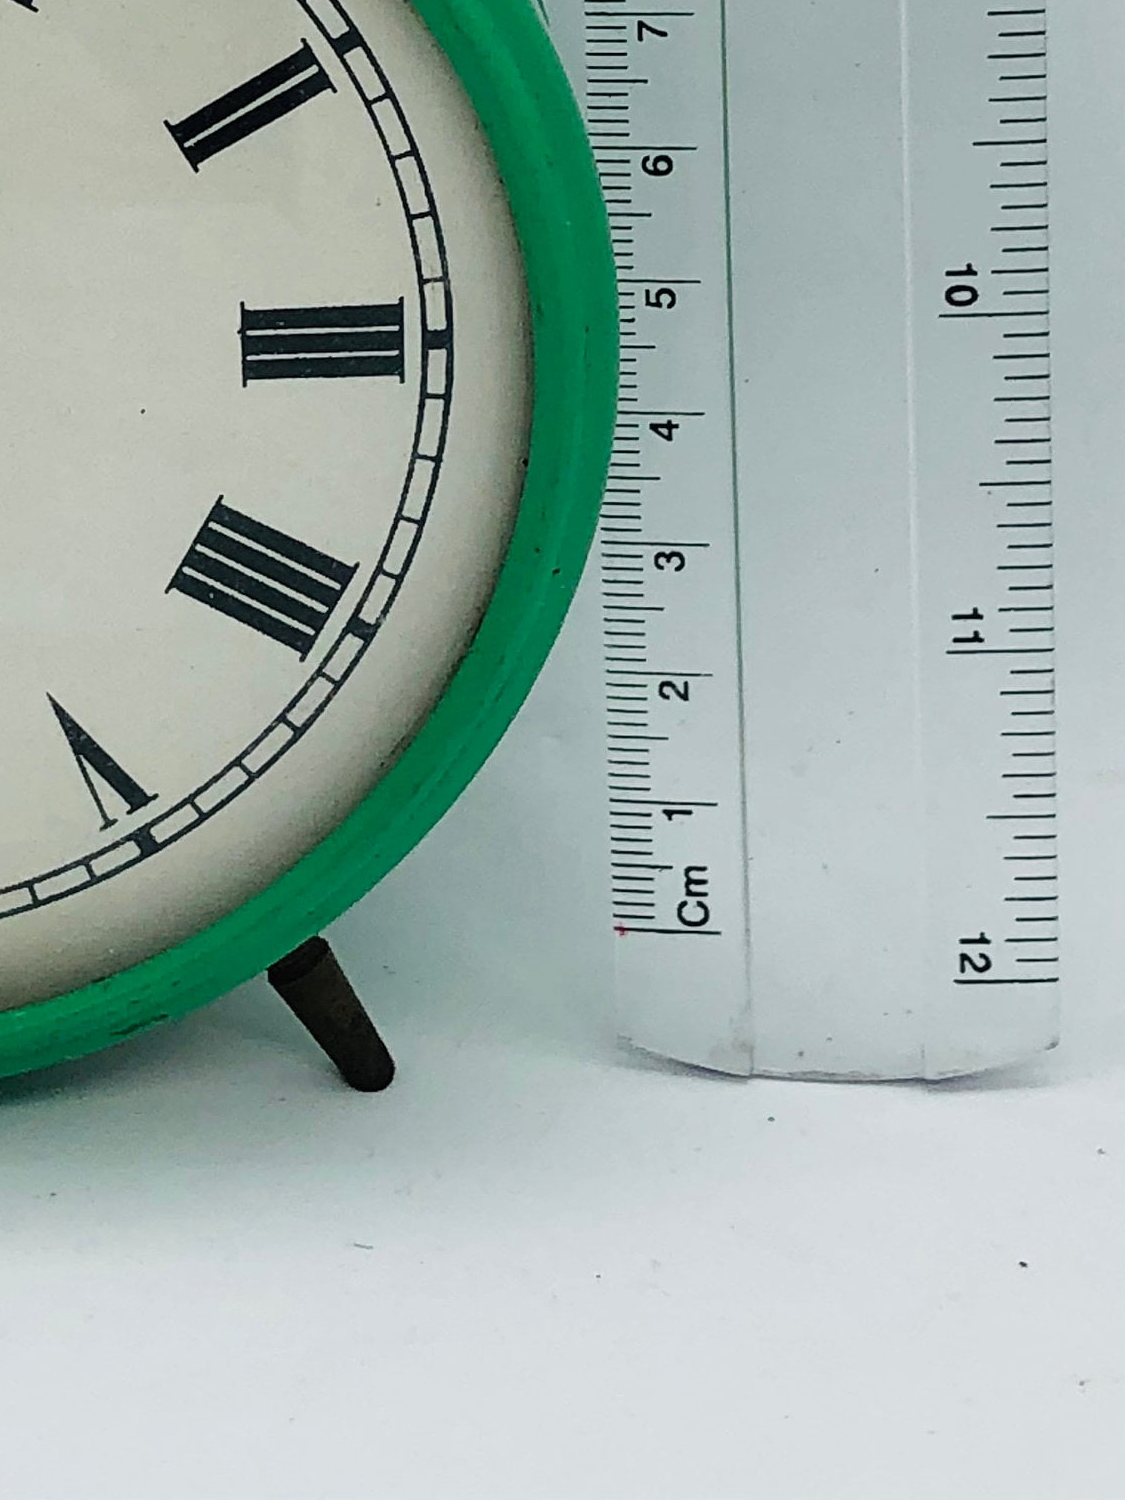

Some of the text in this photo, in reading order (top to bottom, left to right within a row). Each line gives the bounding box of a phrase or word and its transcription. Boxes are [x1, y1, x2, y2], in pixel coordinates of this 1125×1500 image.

[637, 20, 668, 42] 7
[642, 155, 673, 176] 6
[945, 263, 979, 307] 10
[645, 288, 676, 309] 5
[237, 296, 405, 388] III
[649, 420, 679, 441] 4
[654, 551, 685, 571] 3
[952, 608, 984, 643] 11
[659, 681, 689, 701] 2
[662, 809, 693, 821] 1
[677, 866, 709, 927] Cm
[959, 932, 991, 973] 12
